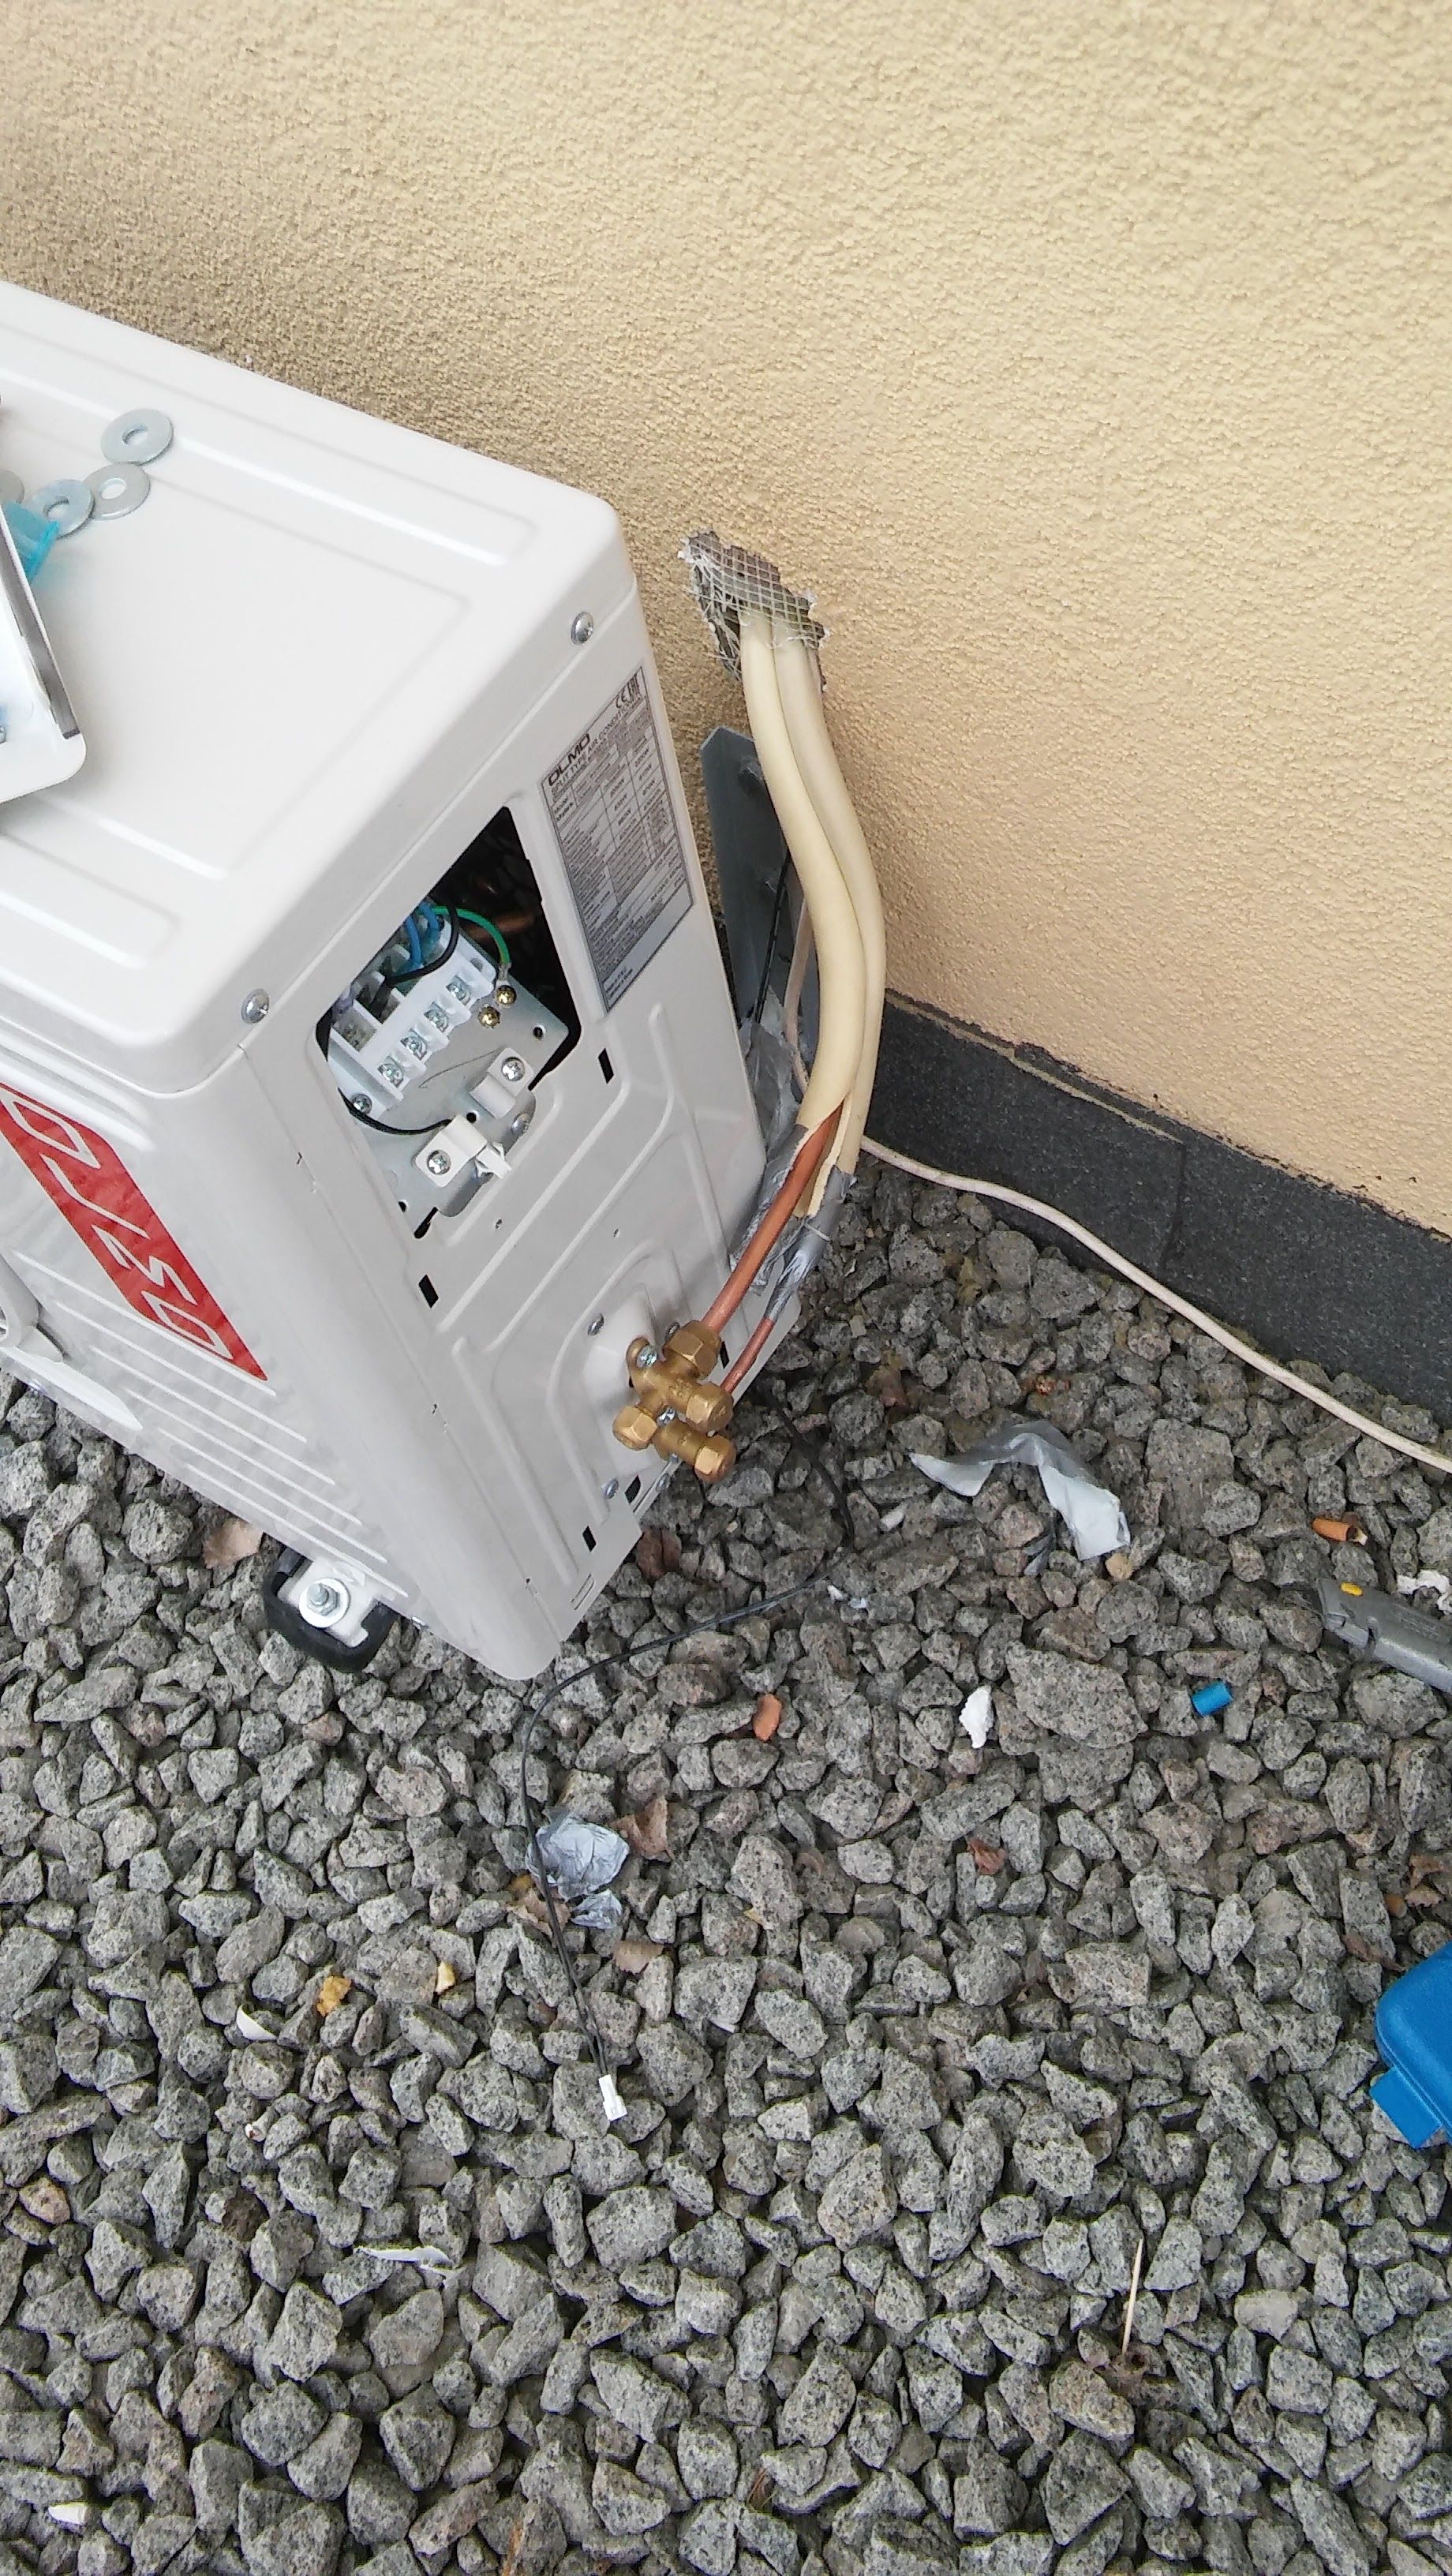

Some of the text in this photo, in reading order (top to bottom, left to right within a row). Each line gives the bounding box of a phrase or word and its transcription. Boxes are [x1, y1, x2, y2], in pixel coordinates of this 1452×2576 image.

[548, 733, 590, 786] OLMO
[551, 768, 571, 796] SPLIT
[571, 751, 586, 773] TYPE
[587, 736, 598, 754] AIR
[0, 1083, 234, 1360] OLMO
